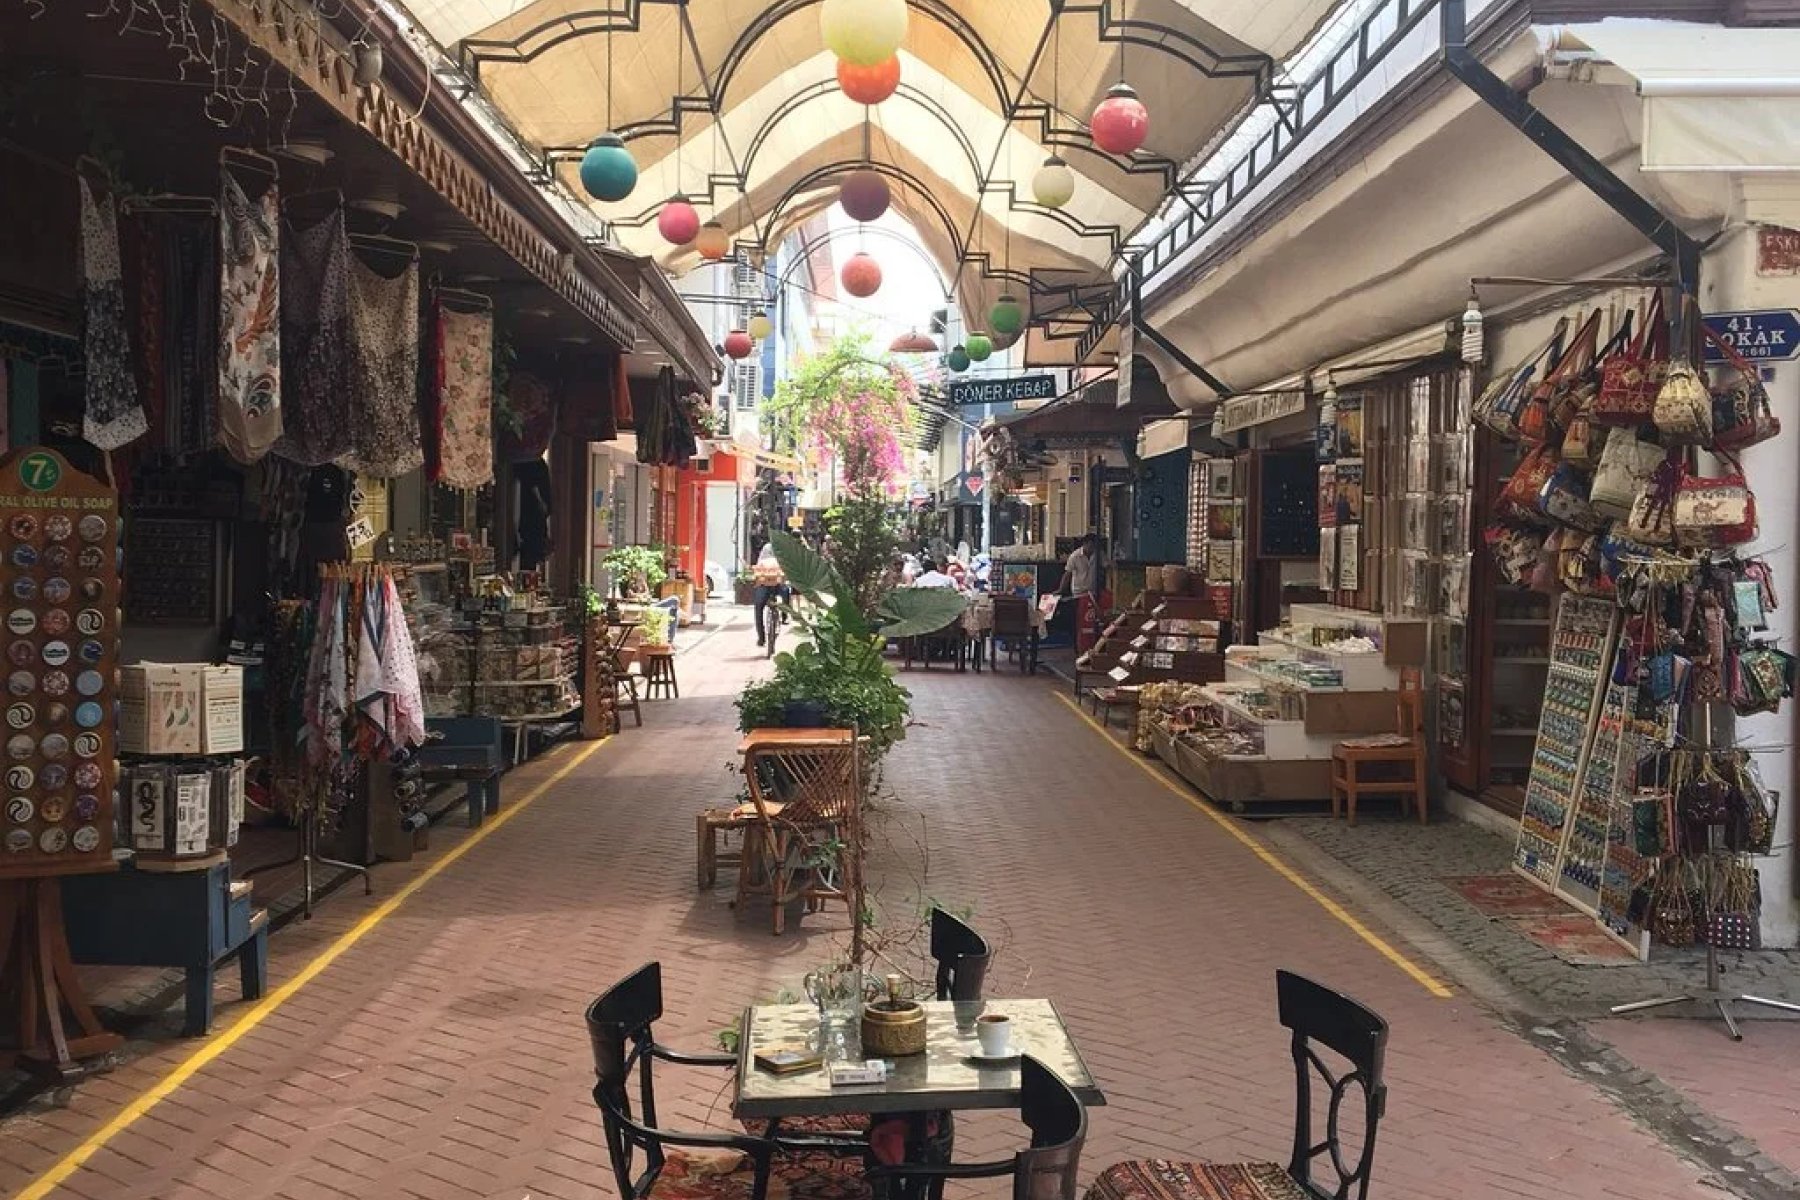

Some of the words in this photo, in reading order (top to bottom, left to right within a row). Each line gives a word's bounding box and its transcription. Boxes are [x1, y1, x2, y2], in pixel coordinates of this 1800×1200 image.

[1728, 317, 1763, 331] 41.
[953, 383, 1002, 403] DÖNER
[1006, 379, 1051, 398] KEBAP
[22, 496, 57, 508] OLIVE
[61, 497, 80, 509] OIL
[83, 497, 113, 510] SOAP
